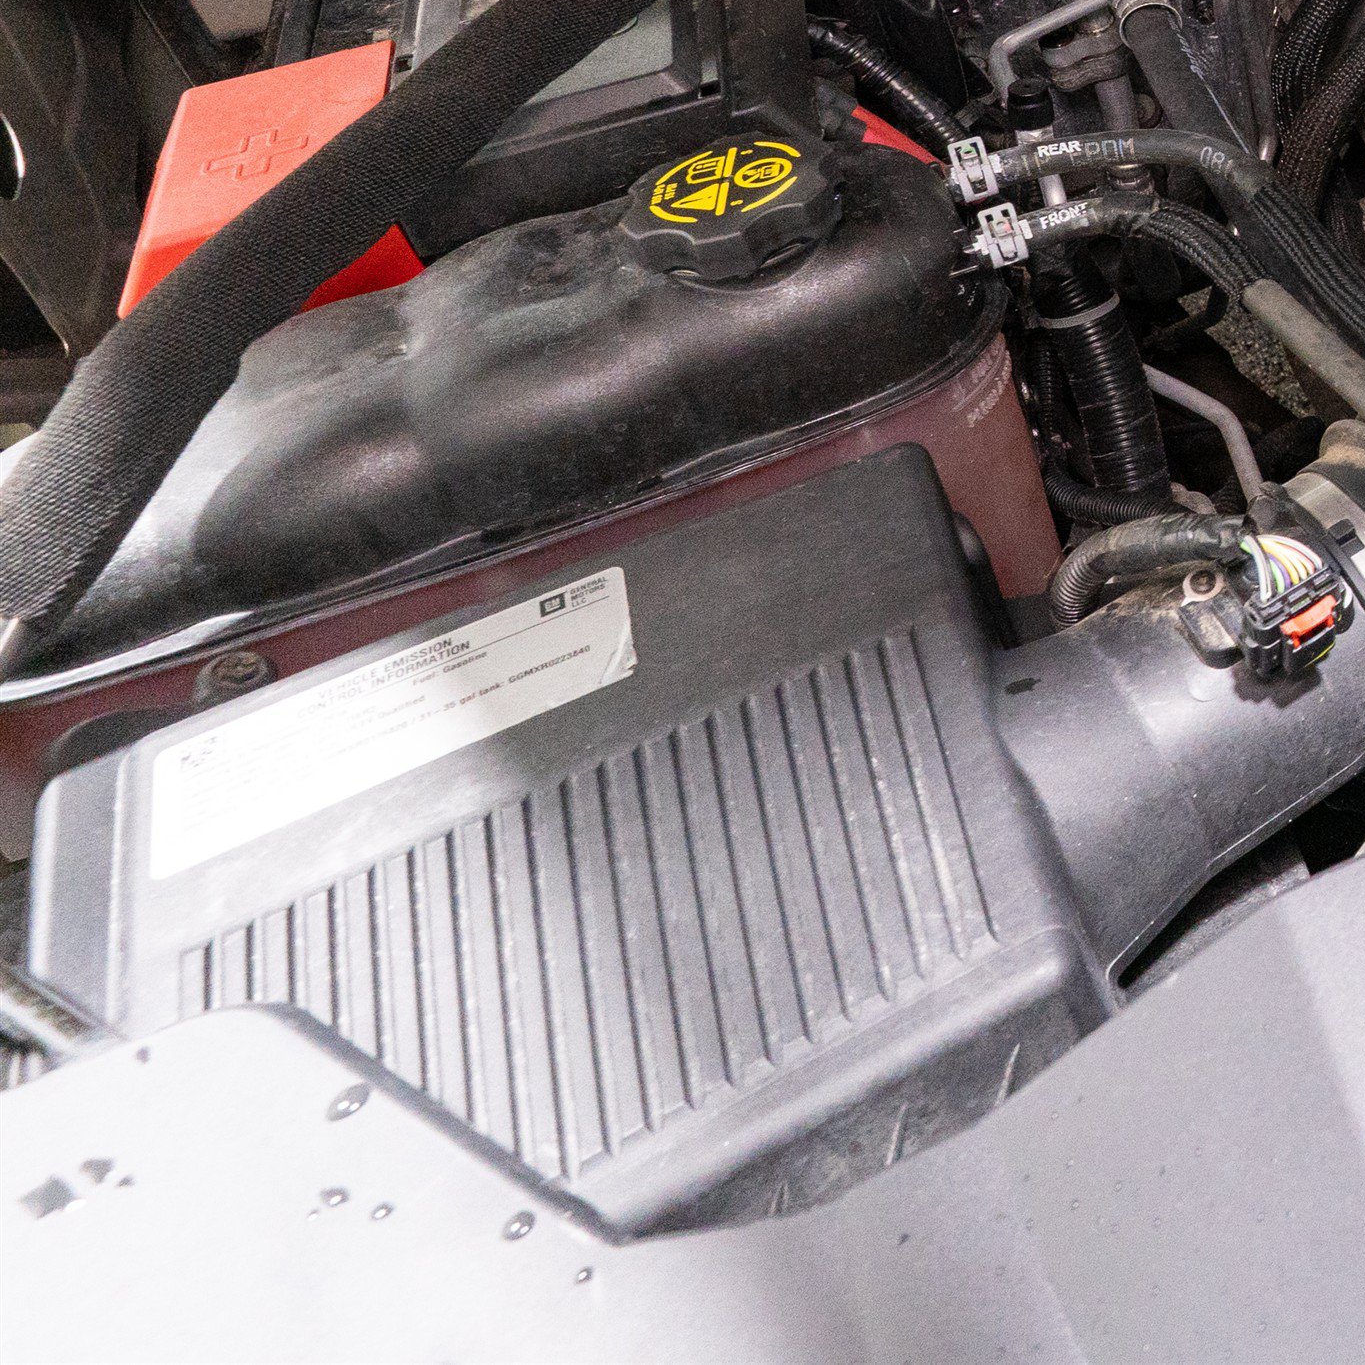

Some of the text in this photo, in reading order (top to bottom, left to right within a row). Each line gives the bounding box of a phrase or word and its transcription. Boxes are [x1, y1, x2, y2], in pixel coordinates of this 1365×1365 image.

[1036, 140, 1081, 158] REAR
[1039, 202, 1089, 231] FRONT
[568, 574, 608, 596] GENERAL
[569, 582, 606, 602] MOTORS
[570, 596, 587, 609] LLC
[318, 636, 453, 700] VEHICLE EMISSION
[441, 648, 487, 674] Gasoline
[296, 639, 470, 720] CONTROL INFORMATION
[377, 693, 425, 720] Qualified
[458, 690, 476, 706] gal
